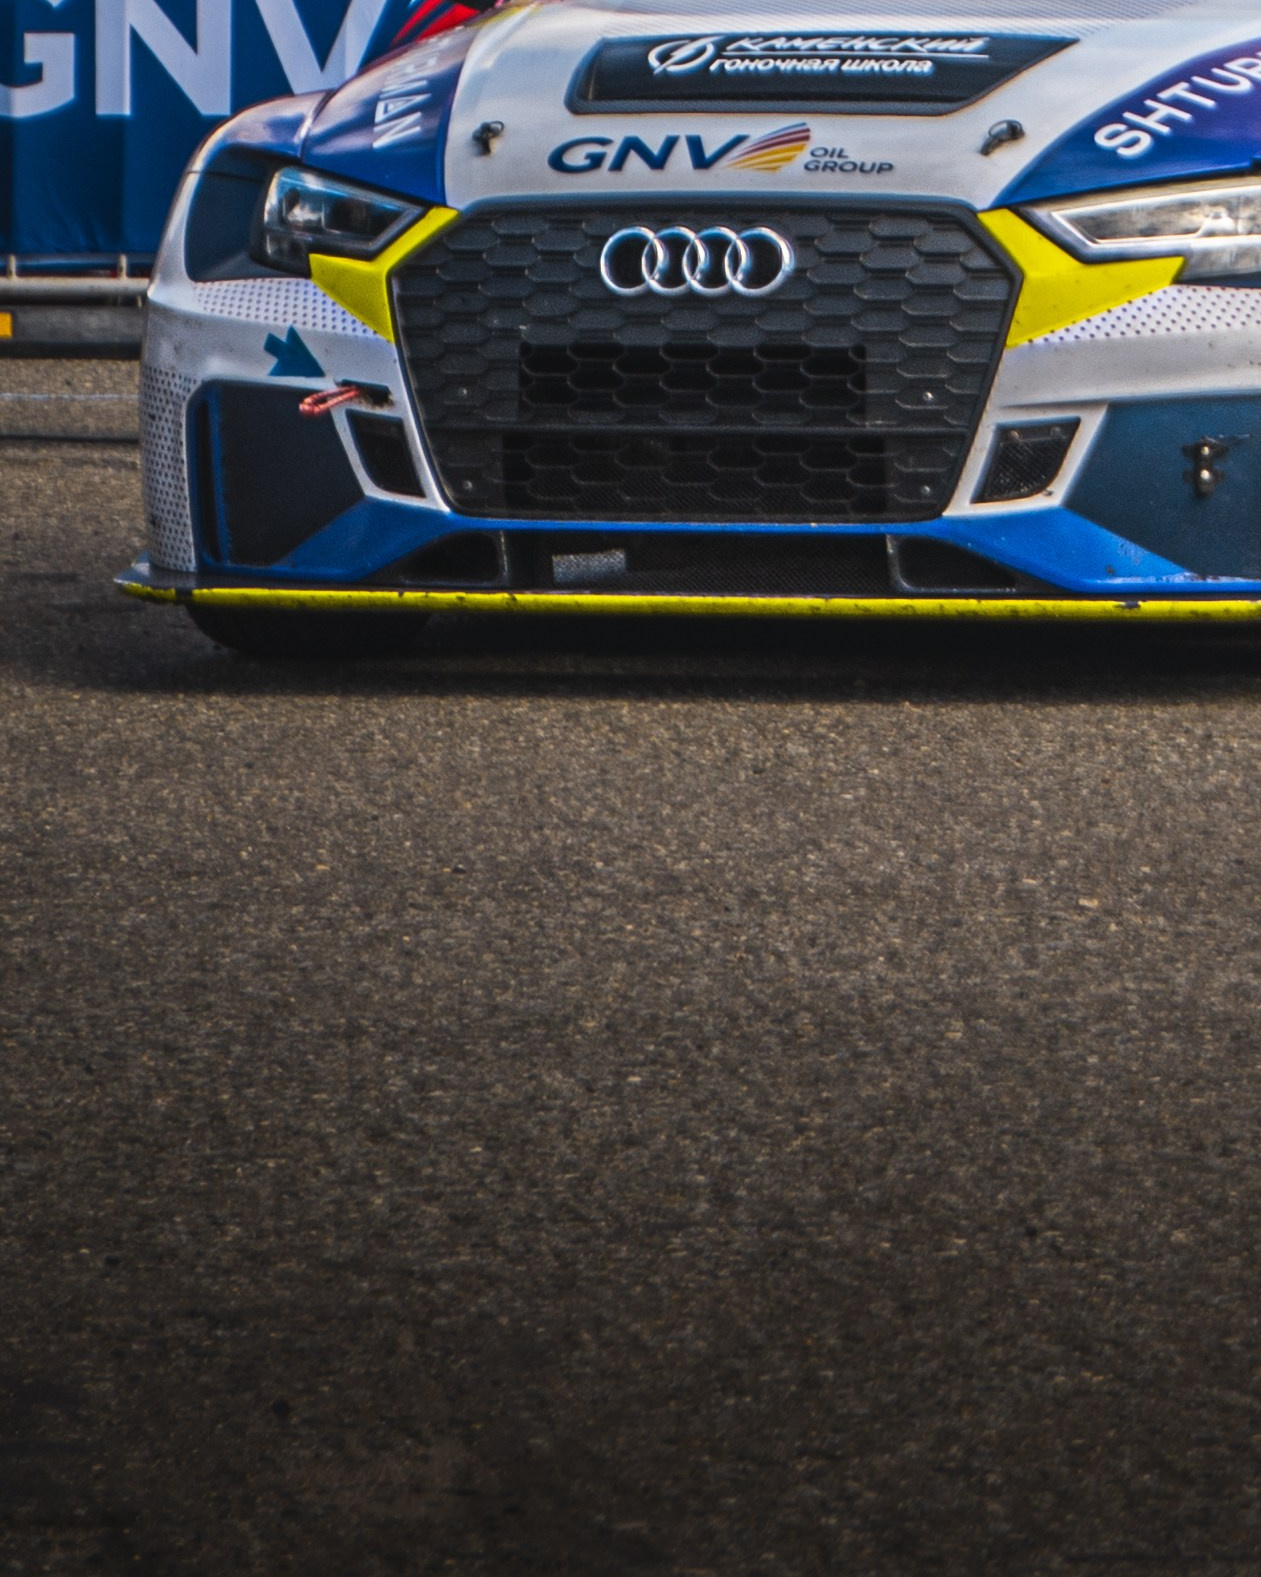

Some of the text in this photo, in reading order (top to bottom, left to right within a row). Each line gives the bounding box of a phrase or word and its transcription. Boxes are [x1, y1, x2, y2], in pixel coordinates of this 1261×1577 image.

[548, 135, 849, 173] GNV OIL
[803, 160, 894, 175] GROUP
